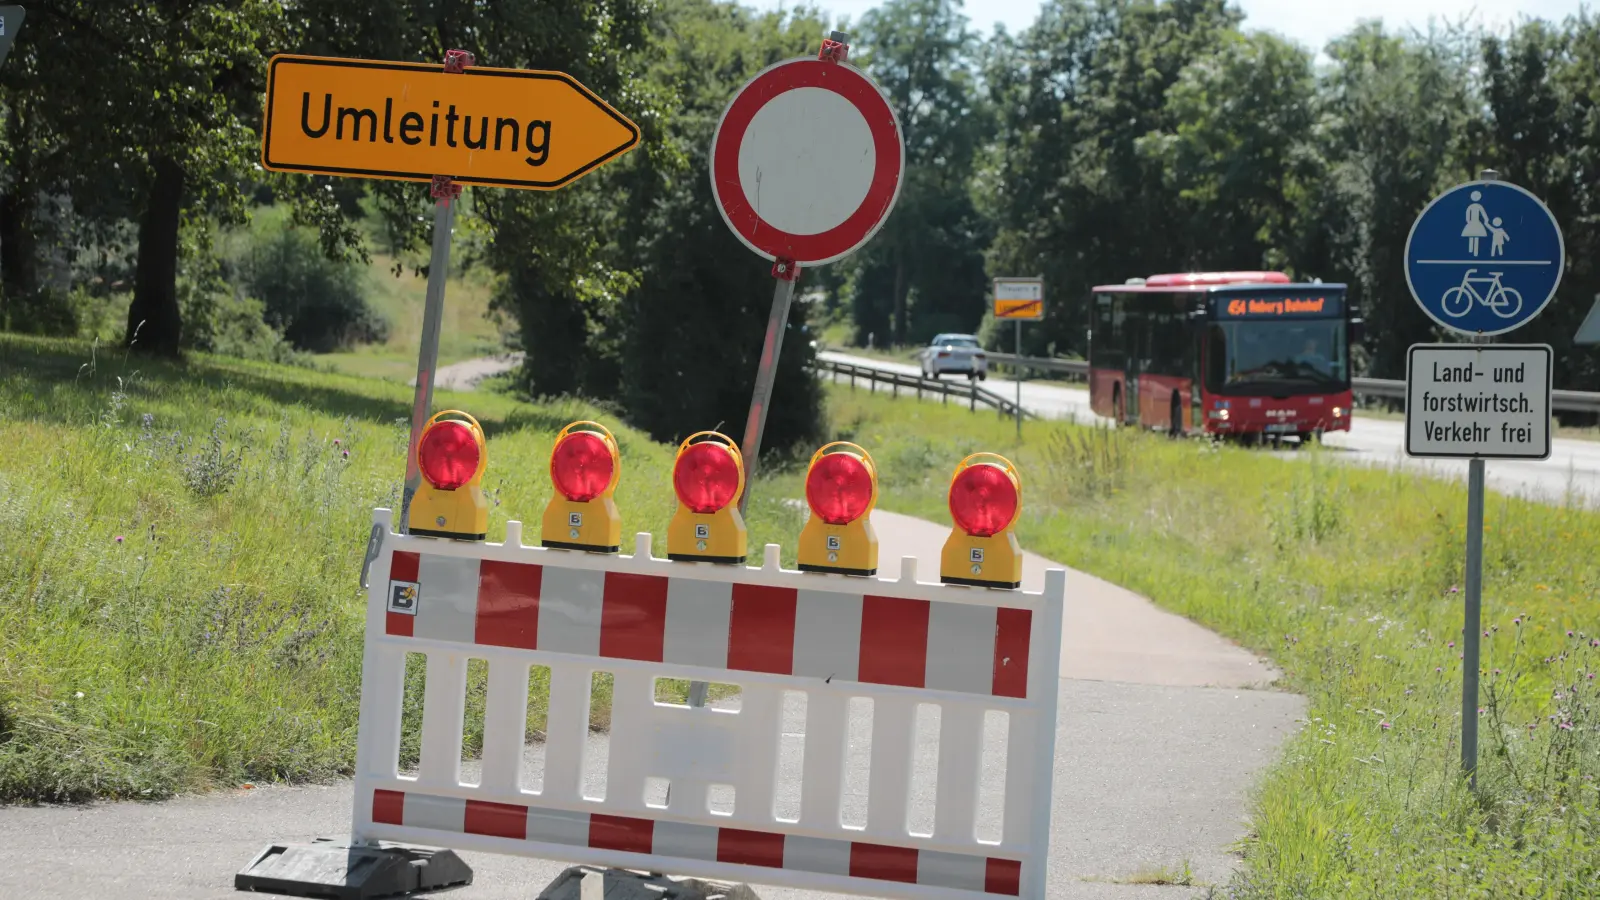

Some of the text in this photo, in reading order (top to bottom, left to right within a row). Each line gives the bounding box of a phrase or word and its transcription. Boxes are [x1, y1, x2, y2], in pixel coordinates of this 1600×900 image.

[301, 91, 552, 167] Umleitung
[1227, 299, 1246, 315] 454
[1285, 297, 1325, 312] Bahnhof
[1433, 361, 1525, 383] Land- und
[1423, 391, 1534, 413] forstwirtsch.
[1424, 420, 1532, 443] Verkehr frei
